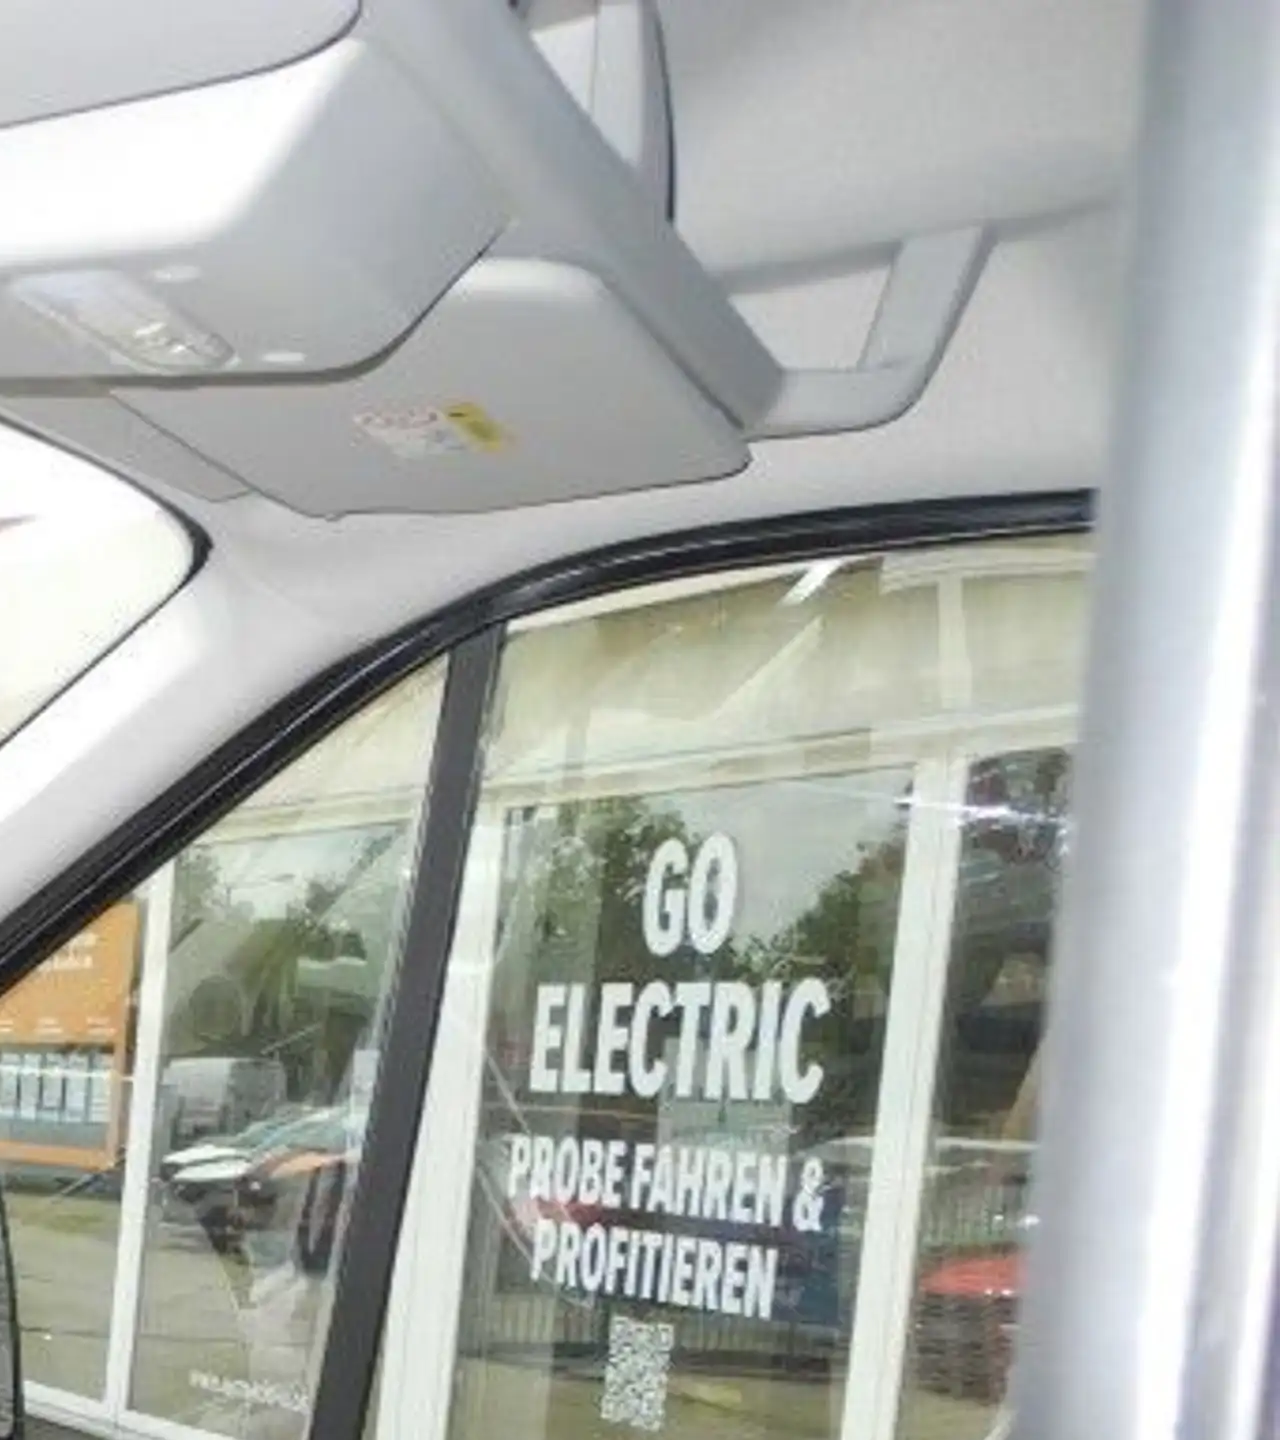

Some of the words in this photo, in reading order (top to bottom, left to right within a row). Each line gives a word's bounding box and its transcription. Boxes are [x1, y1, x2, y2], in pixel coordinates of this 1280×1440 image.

[641, 831, 738, 956] GO
[528, 977, 831, 1104] ELECTRIC
[508, 1135, 630, 1206] PROBE
[631, 1143, 788, 1230] FAHREN
[799, 1157, 823, 1232] &
[530, 1218, 777, 1320] PROFITIEREN
